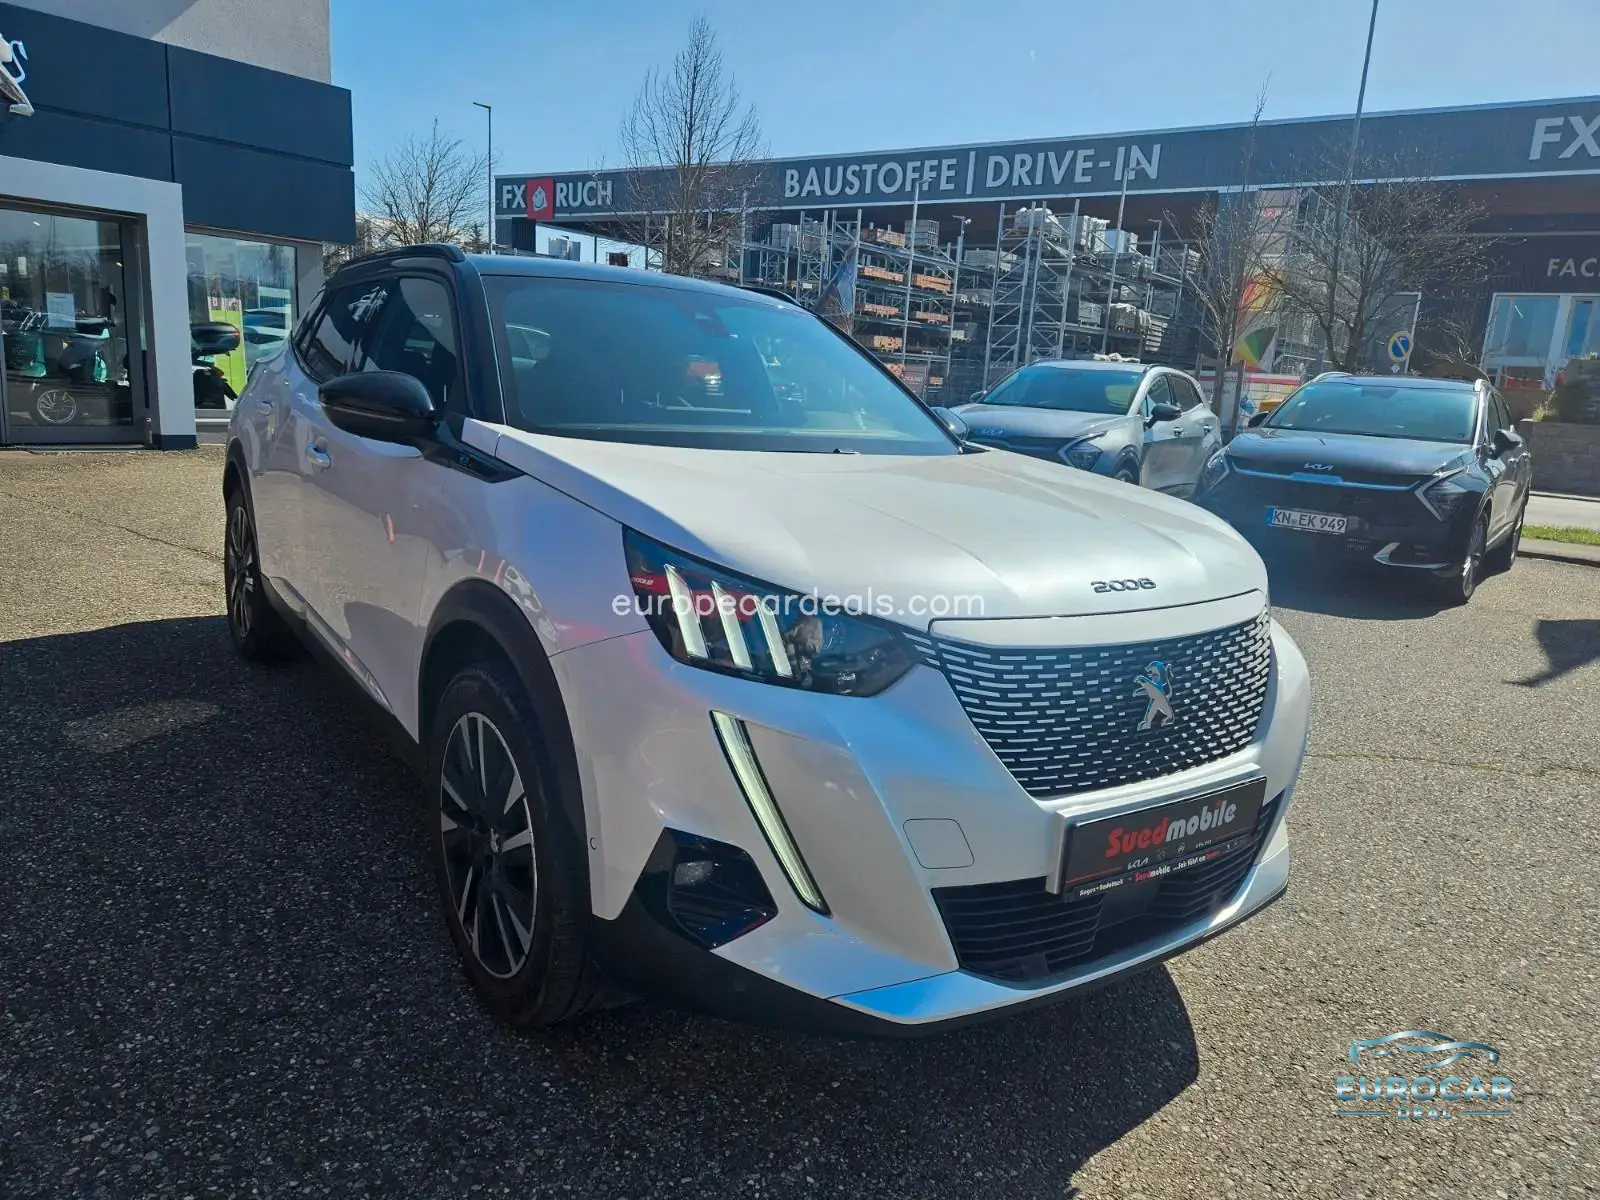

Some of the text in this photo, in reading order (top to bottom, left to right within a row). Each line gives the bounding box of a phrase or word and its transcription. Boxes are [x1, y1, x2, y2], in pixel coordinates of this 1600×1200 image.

[1529, 115, 1600, 160] FX
[784, 143, 1162, 198] BAUSTOFFE DRIVE-IN
[502, 180, 613, 209] FX RUCH
[1546, 257, 1600, 278] FAC
[1273, 511, 1345, 532] KN EK 949
[1104, 798, 1237, 858] Suedmobile
